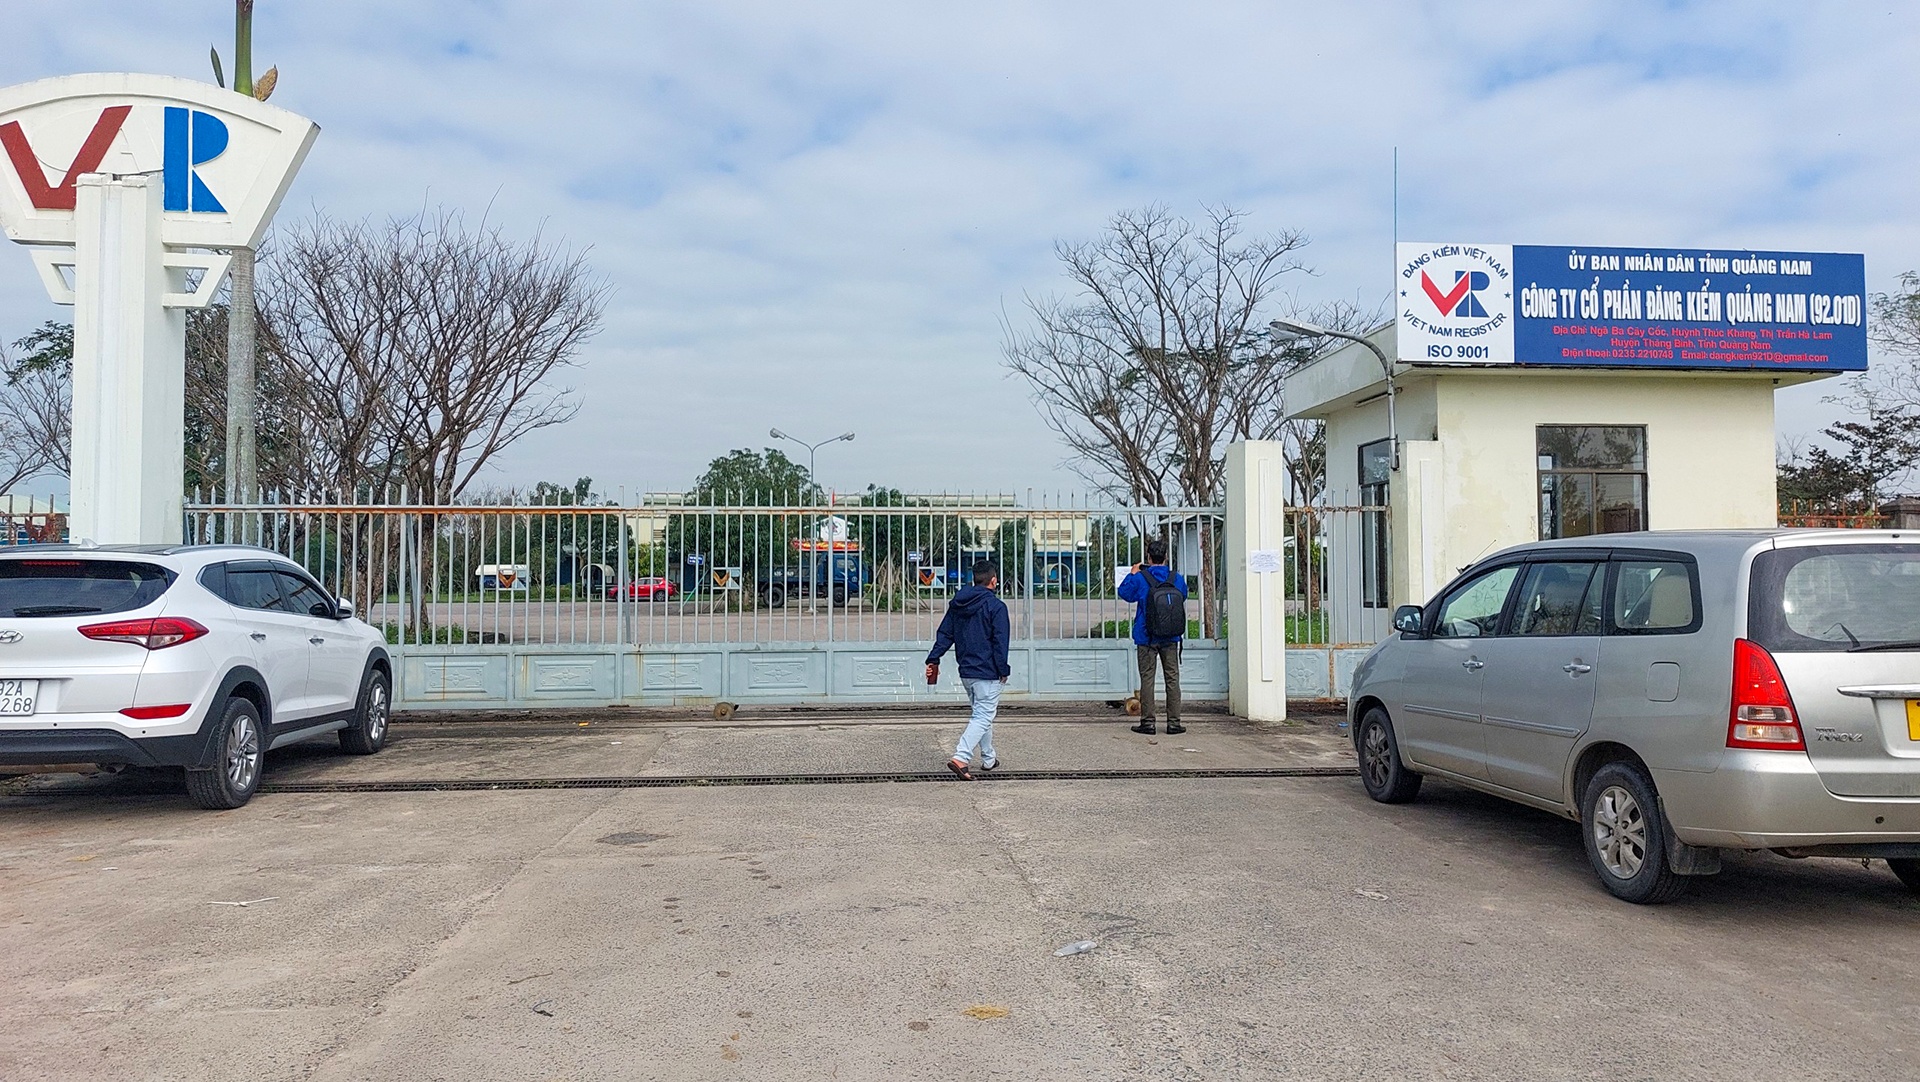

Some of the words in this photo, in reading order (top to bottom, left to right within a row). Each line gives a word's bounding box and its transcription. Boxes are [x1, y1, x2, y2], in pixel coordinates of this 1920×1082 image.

[1463, 246, 1487, 260] VIỆT
[1485, 256, 1509, 280] NAM
[1568, 250, 1587, 271] ỦY
[1591, 255, 1620, 271] BAN
[1625, 253, 1664, 272] NHÂN
[1666, 254, 1695, 273] DÂN
[1698, 252, 1729, 273] TỈNH
[1731, 253, 1777, 275] QUẢNG
[1780, 260, 1812, 276] NAM
[1521, 282, 1557, 319] CÔNG
[1560, 288, 1577, 319] TY
[1580, 276, 1600, 320] CỔ
[1603, 279, 1642, 320] PHẦN
[1646, 284, 1683, 321] ĐĂNG
[1686, 278, 1721, 322] KIỂM
[1726, 283, 1772, 326] QUẢNG
[1775, 293, 1807, 324] NAM
[1809, 292, 1861, 326] (92.01D)
[1402, 308, 1428, 331] VIET
[1428, 324, 1453, 337] NAM
[1454, 312, 1507, 338] REGISTER
[1553, 325, 1569, 336] Địa
[1611, 326, 1624, 335] Ba
[1626, 326, 1645, 338] Cây
[1671, 327, 1701, 339] Huỳnh
[1702, 328, 1725, 337] Thúc
[1760, 329, 1774, 339] Thị
[1798, 330, 1810, 340] Hà
[1812, 330, 1833, 340] Lam
[1427, 345, 1453, 358] ISO
[1457, 345, 1489, 359] 9001
[1562, 348, 1584, 358] Điện
[1610, 338, 1640, 349] Huyện
[1719, 340, 1749, 351] Quảng
